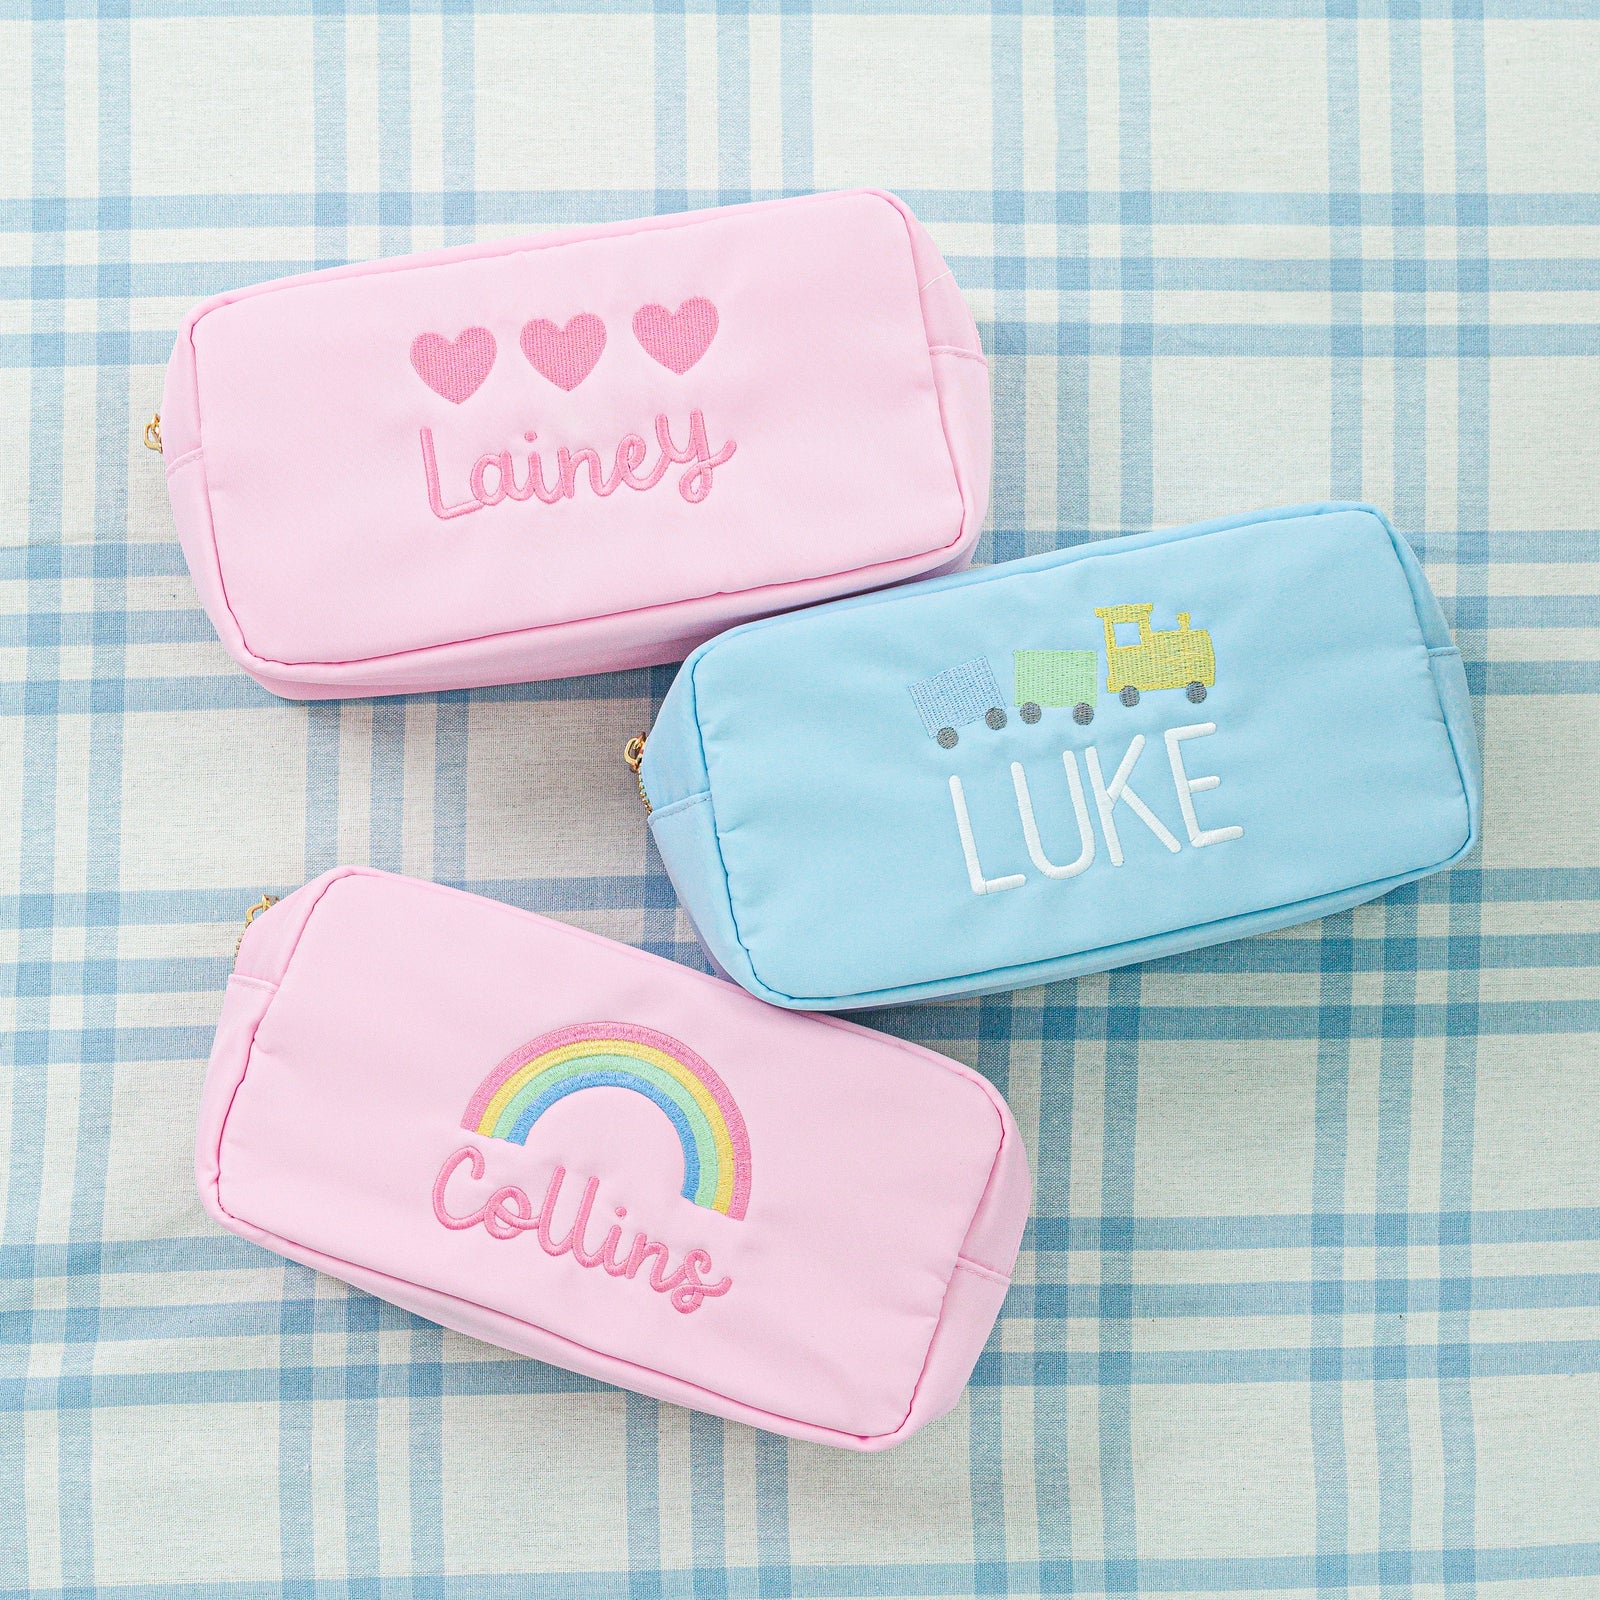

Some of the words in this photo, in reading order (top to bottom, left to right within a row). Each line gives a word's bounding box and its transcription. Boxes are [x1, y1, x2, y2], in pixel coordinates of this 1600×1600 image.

[420, 408, 737, 520] Lainey
[949, 722, 1243, 895] LUKE
[432, 1145, 732, 1314] Collins
